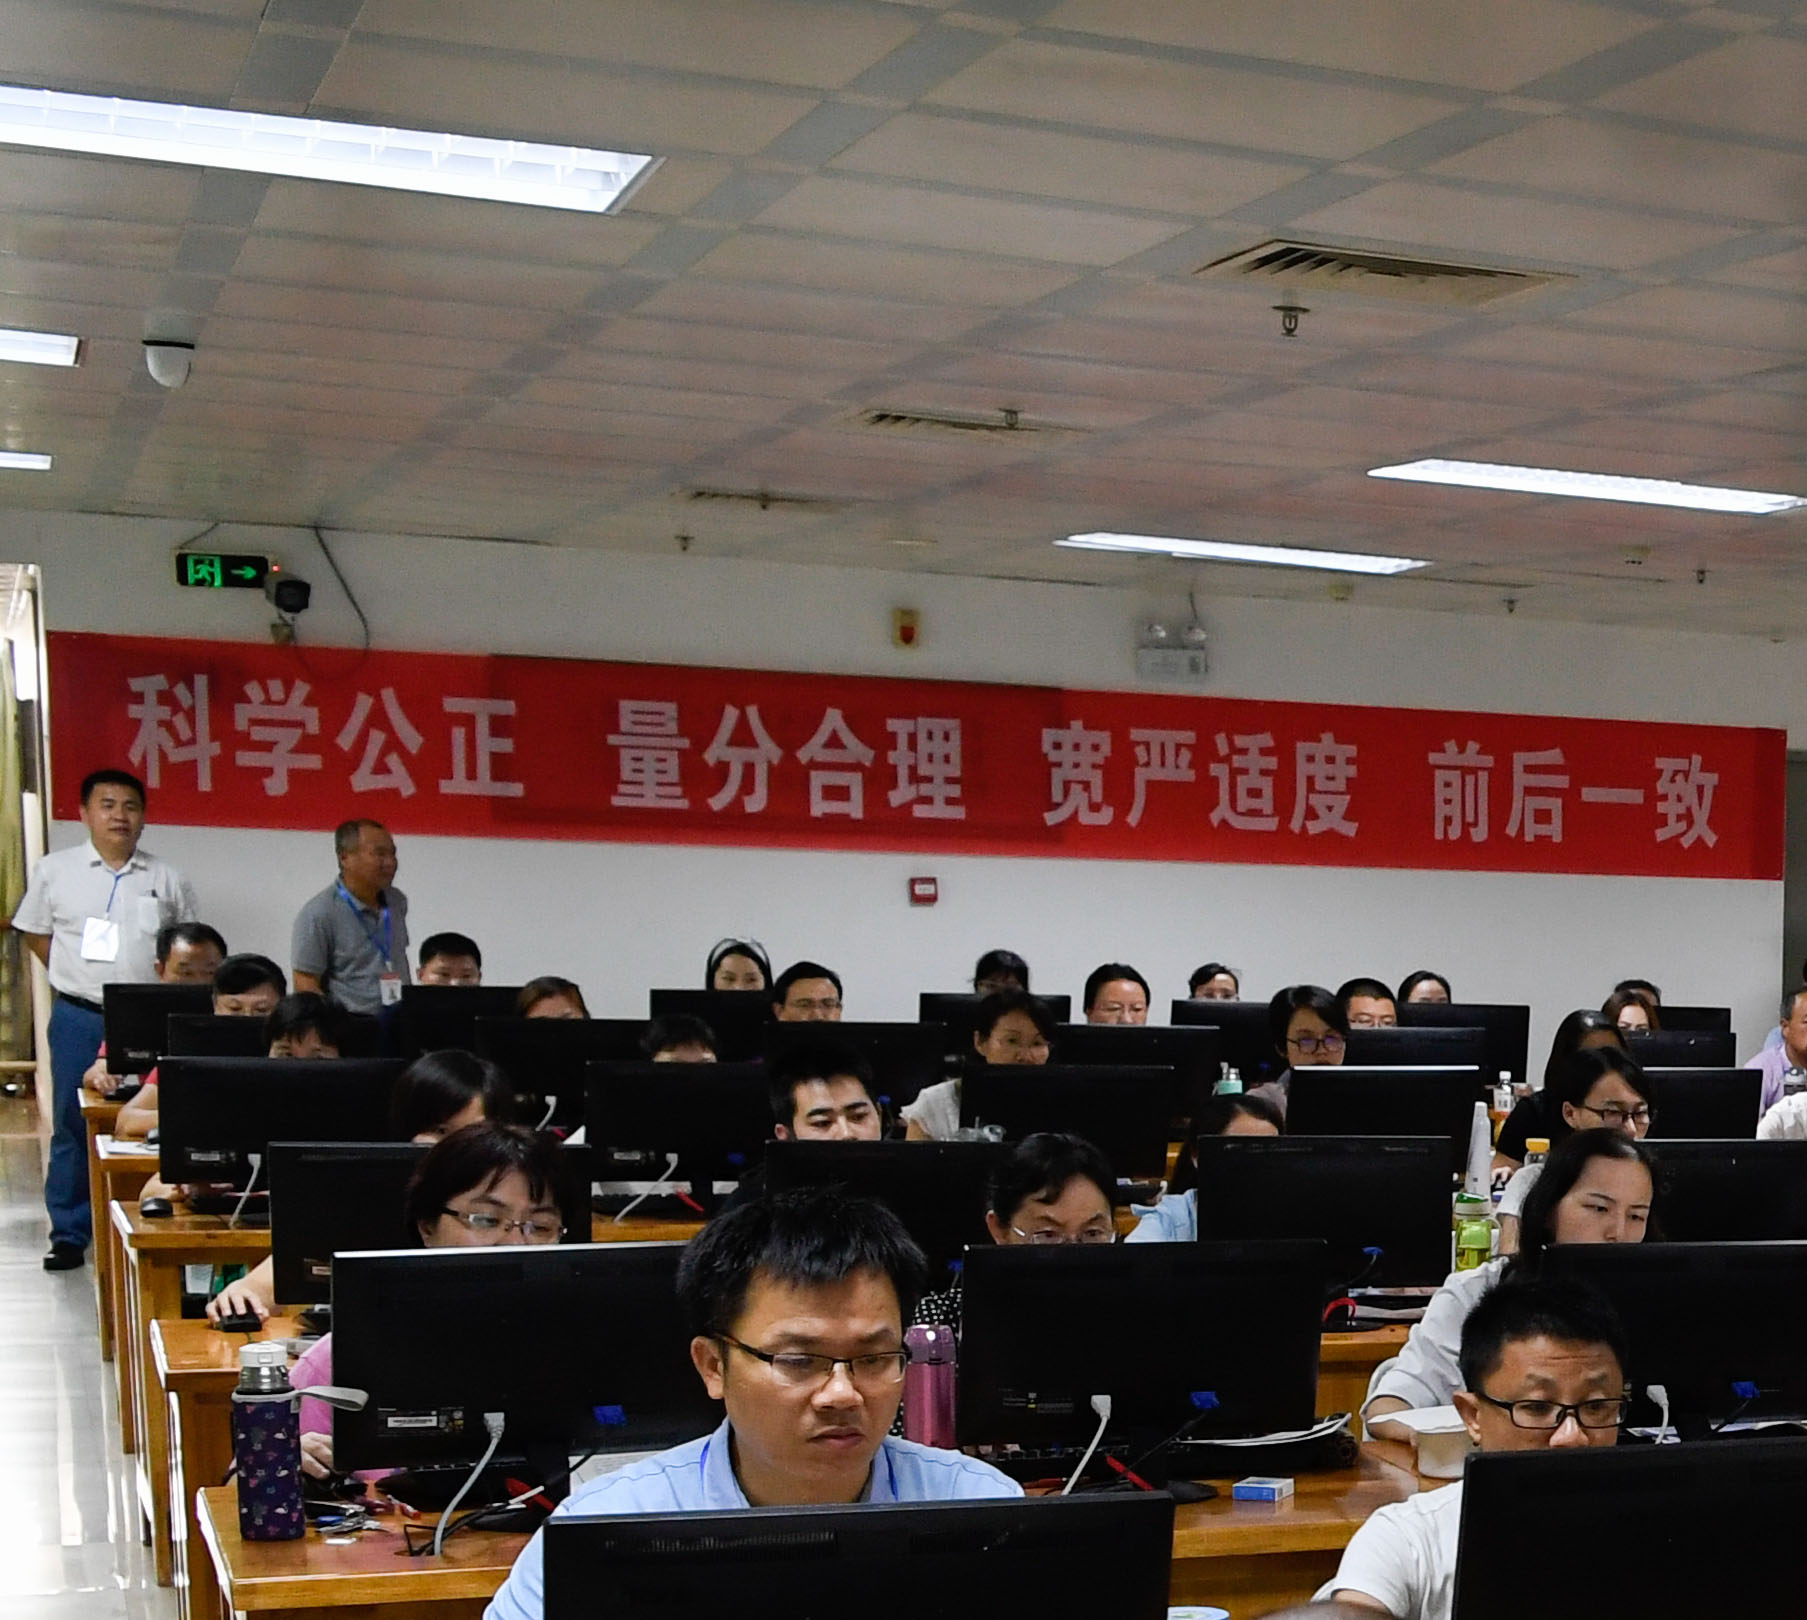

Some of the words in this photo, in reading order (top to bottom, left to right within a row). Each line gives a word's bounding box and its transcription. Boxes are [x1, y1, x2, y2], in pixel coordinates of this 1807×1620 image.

[126, 672, 526, 800] 科学公正
[606, 698, 966, 822] 量分合理
[1041, 718, 1360, 838] 宽严适度
[1428, 739, 1720, 849] 前后一致
